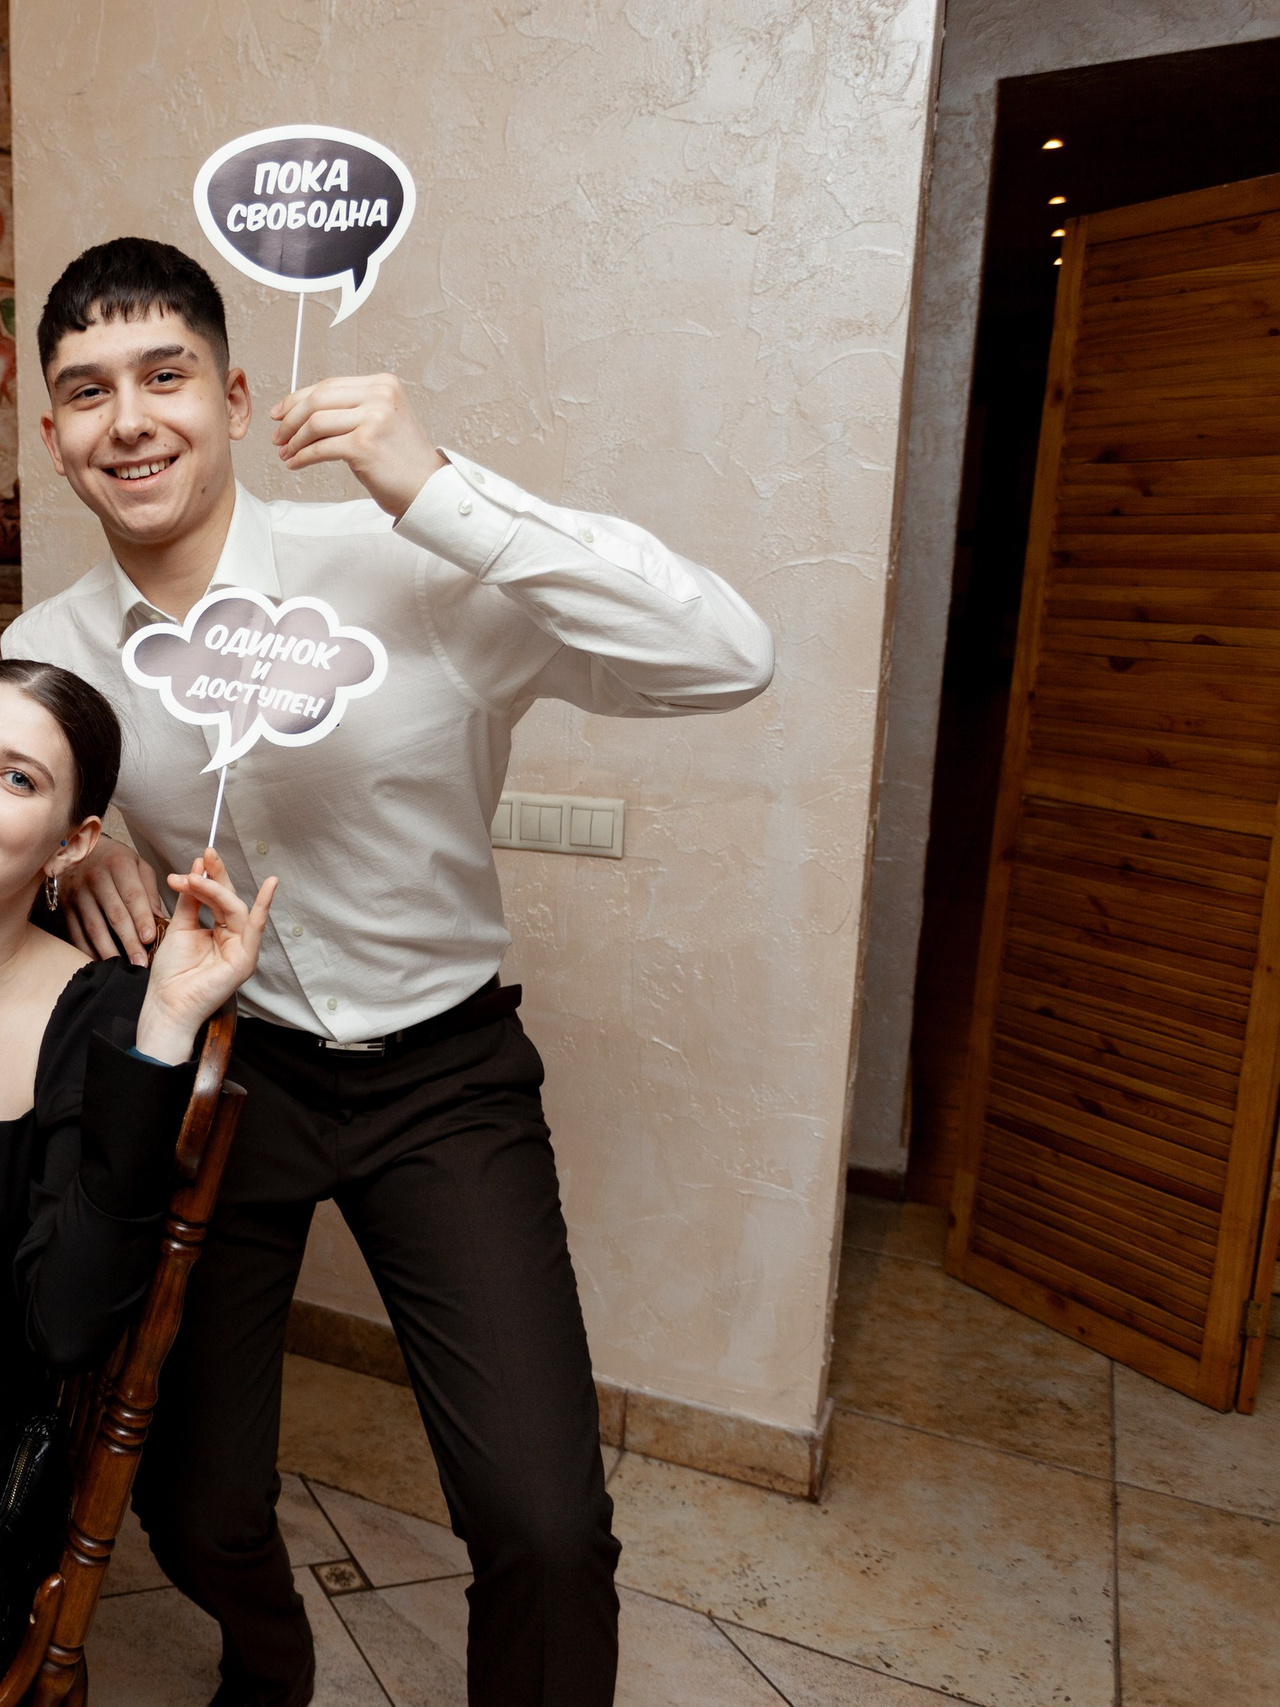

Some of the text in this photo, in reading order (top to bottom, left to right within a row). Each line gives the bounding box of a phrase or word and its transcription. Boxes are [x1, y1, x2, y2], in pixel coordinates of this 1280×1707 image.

[253, 158, 349, 196] ПОКА
[226, 198, 389, 233] СВОБОДНА
[204, 623, 341, 671] ОДИНОК
[250, 660, 273, 681] И
[185, 674, 326, 720] ДОСТУПЕН
